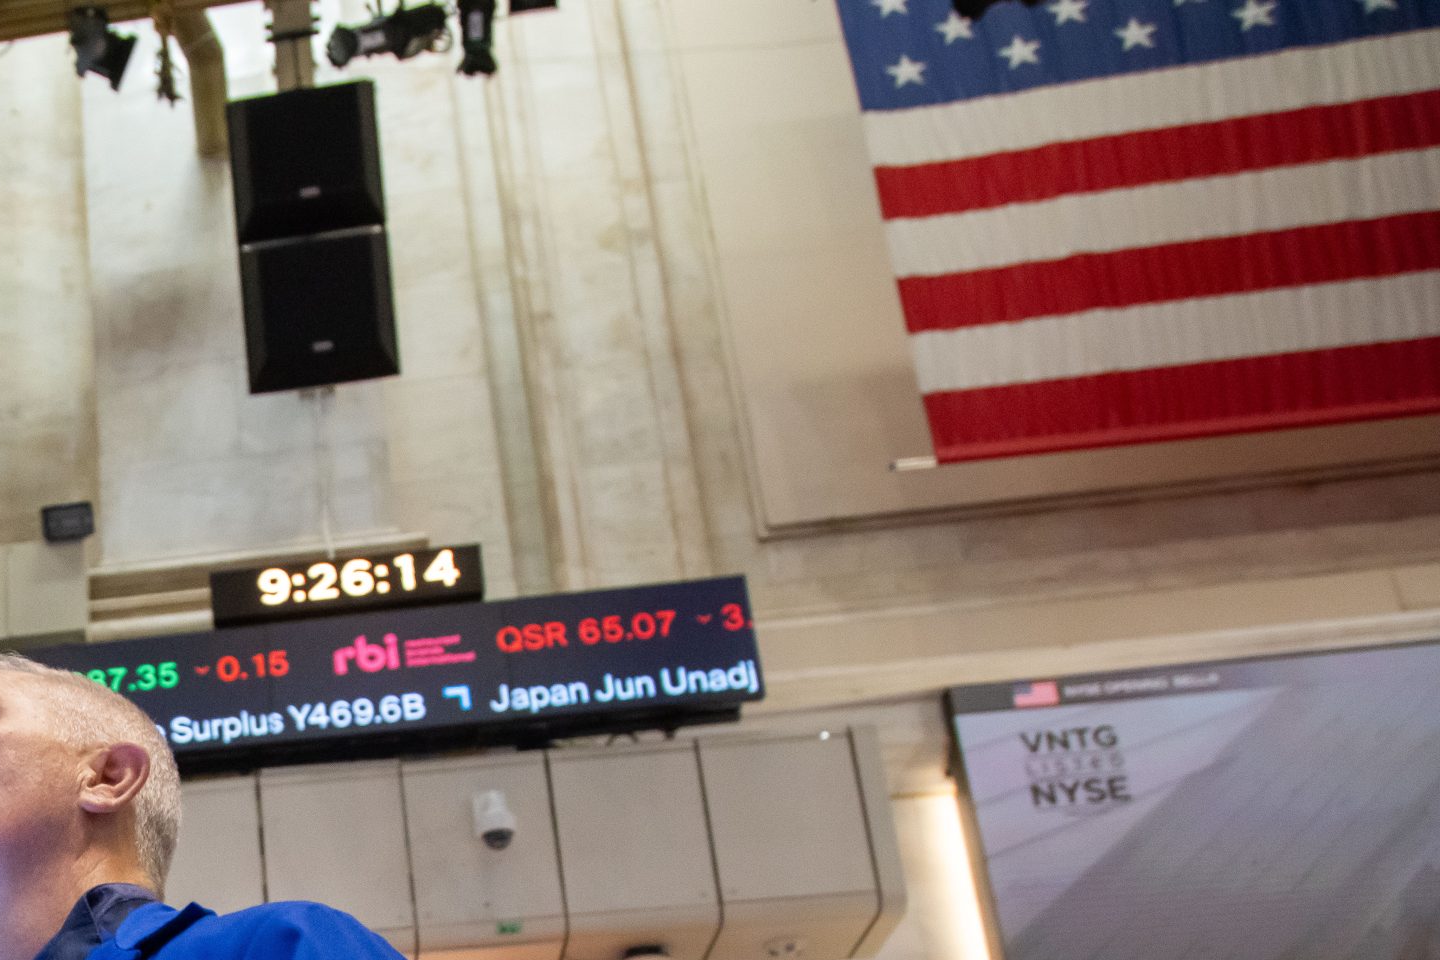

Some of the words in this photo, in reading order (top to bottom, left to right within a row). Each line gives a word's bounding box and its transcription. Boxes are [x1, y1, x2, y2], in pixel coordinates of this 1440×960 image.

[257, 549, 461, 605] 9:26:14
[496, 621, 569, 653] QSR
[578, 610, 677, 645] 65.07
[216, 650, 289, 682] 0.15
[333, 632, 401, 676] rbi
[169, 710, 285, 744] Surplus
[287, 692, 427, 732] Y469.6B
[490, 684, 590, 713] Japan
[594, 673, 657, 702] Jun
[659, 659, 760, 696] Unadj
[1019, 724, 1119, 753] VNTG
[1030, 775, 1132, 806] NYSE
